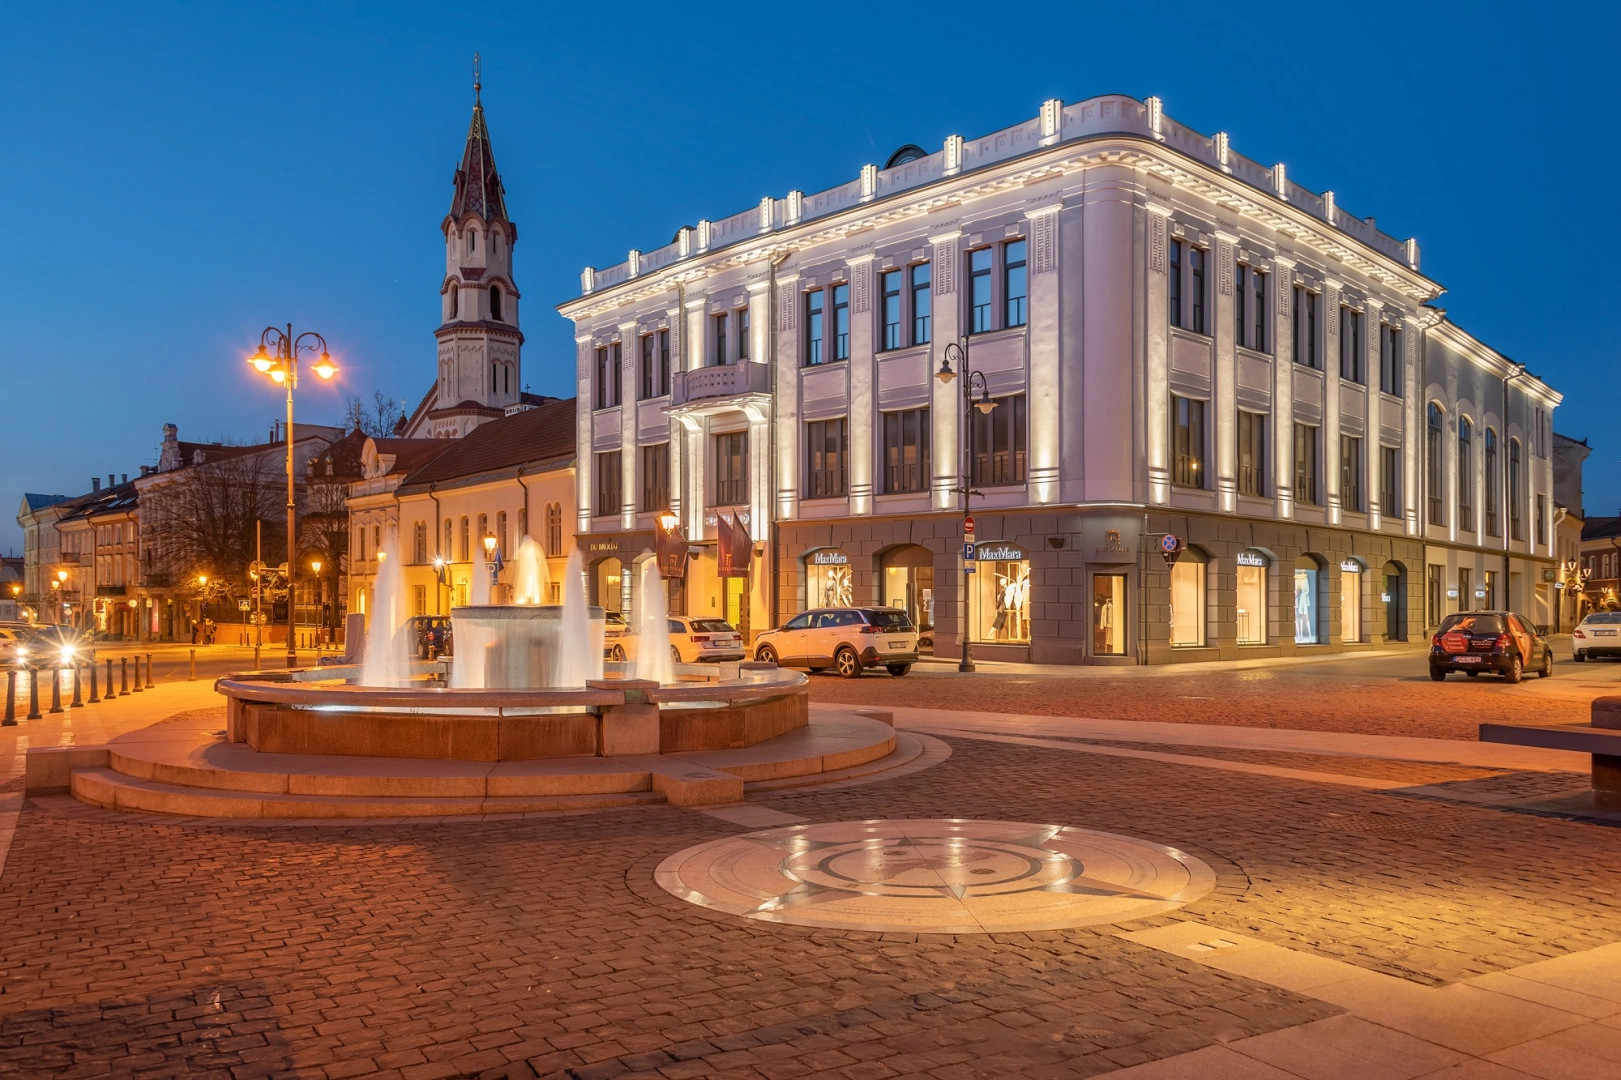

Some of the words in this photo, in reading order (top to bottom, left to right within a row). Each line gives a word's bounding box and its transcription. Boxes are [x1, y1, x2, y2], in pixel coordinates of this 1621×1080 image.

[814, 552, 847, 564] MaxMara
[966, 544, 974, 559] P
[978, 547, 1021, 560] MaxMara
